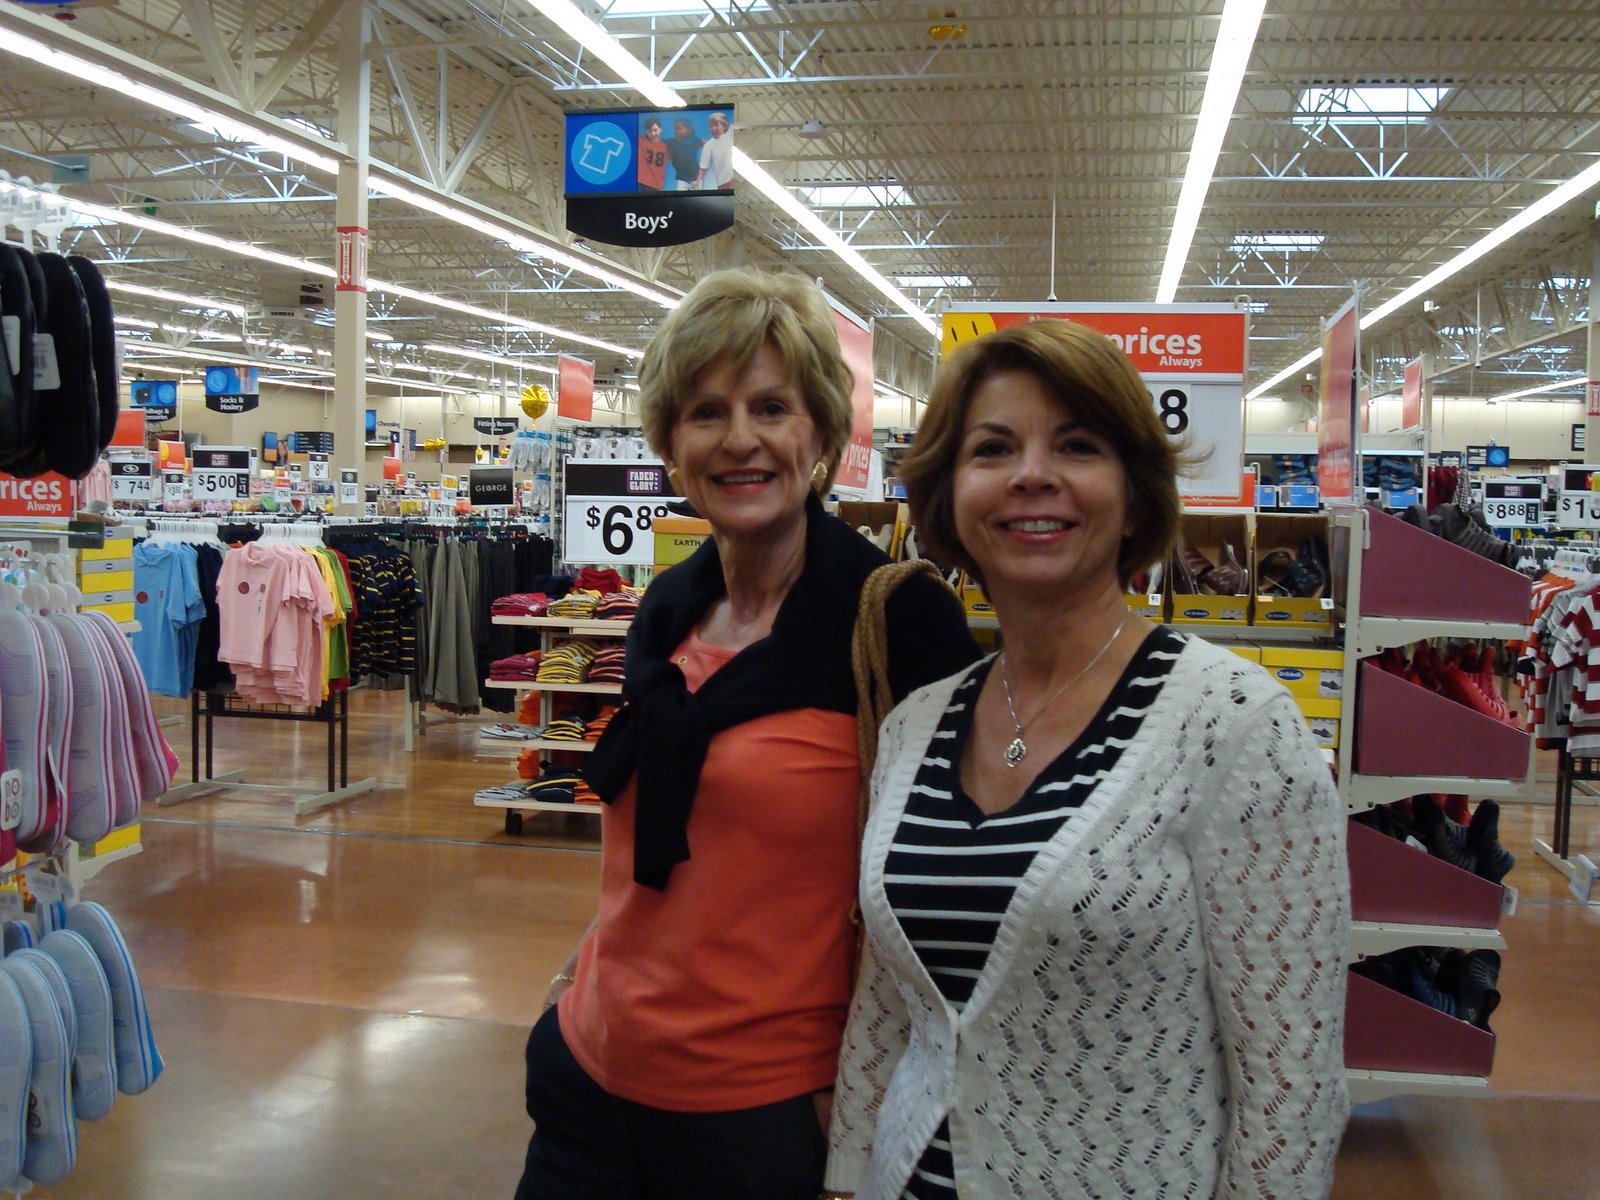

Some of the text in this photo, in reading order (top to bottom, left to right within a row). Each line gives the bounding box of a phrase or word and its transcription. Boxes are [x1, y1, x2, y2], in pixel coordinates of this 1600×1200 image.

[646, 150, 665, 167] 38
[625, 211, 673, 233] Boys'
[1159, 356, 1203, 368] Always
[629, 471, 654, 481] FADED
[0, 480, 62, 500] rices
[629, 481, 654, 491] GLORY
[27, 501, 62, 513] Always
